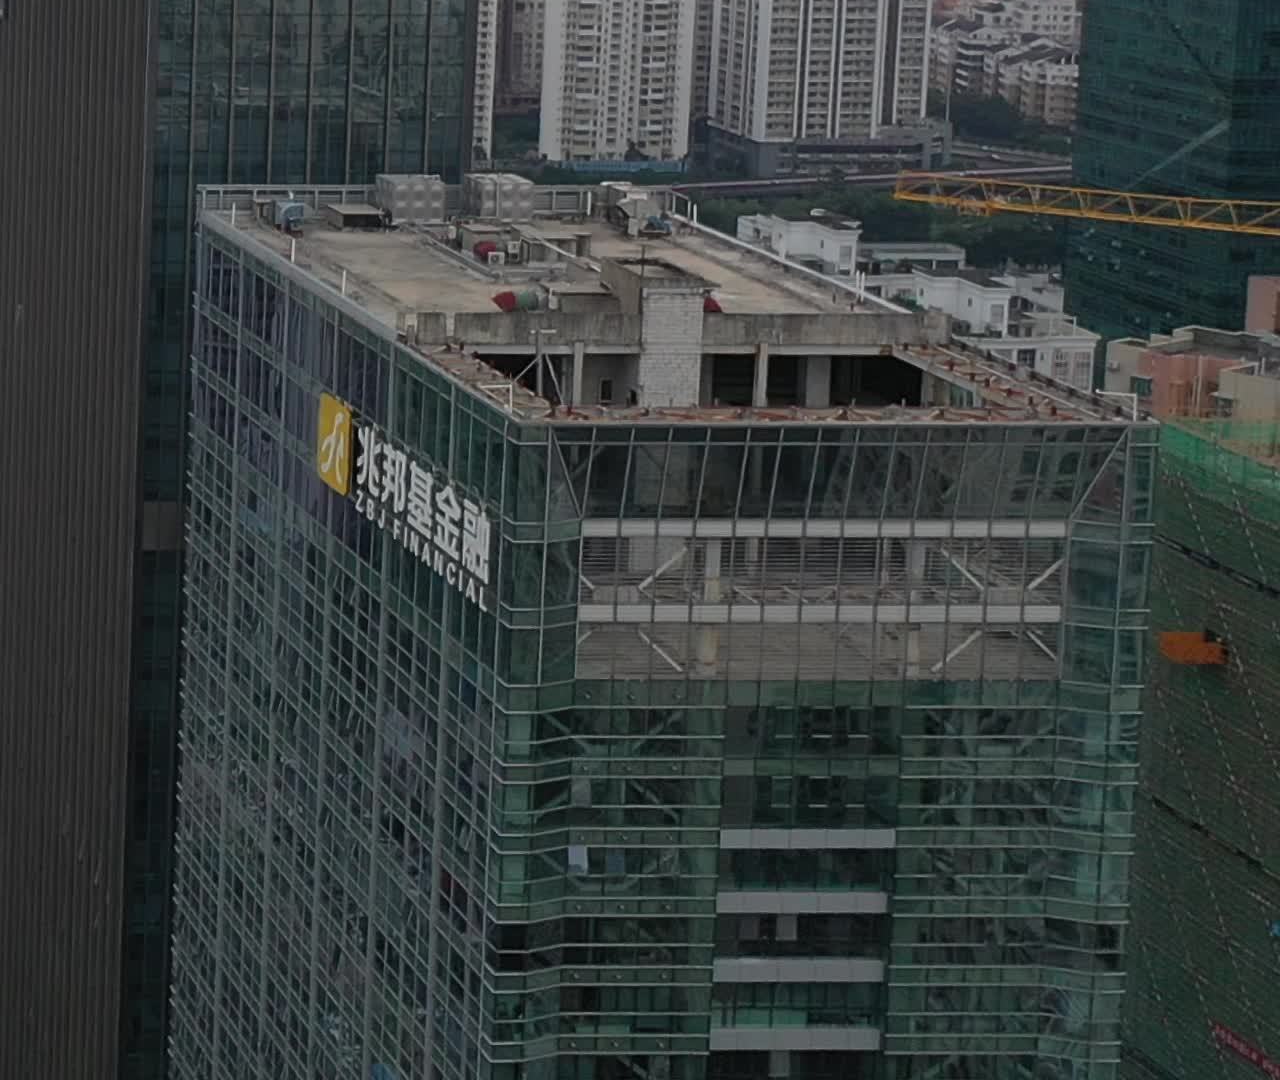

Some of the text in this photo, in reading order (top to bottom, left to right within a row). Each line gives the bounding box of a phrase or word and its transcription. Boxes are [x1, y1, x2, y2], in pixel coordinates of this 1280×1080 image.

[355, 490, 487, 612] ZBJ FINANCIAL
[356, 426, 490, 585] 兆邦基金融
